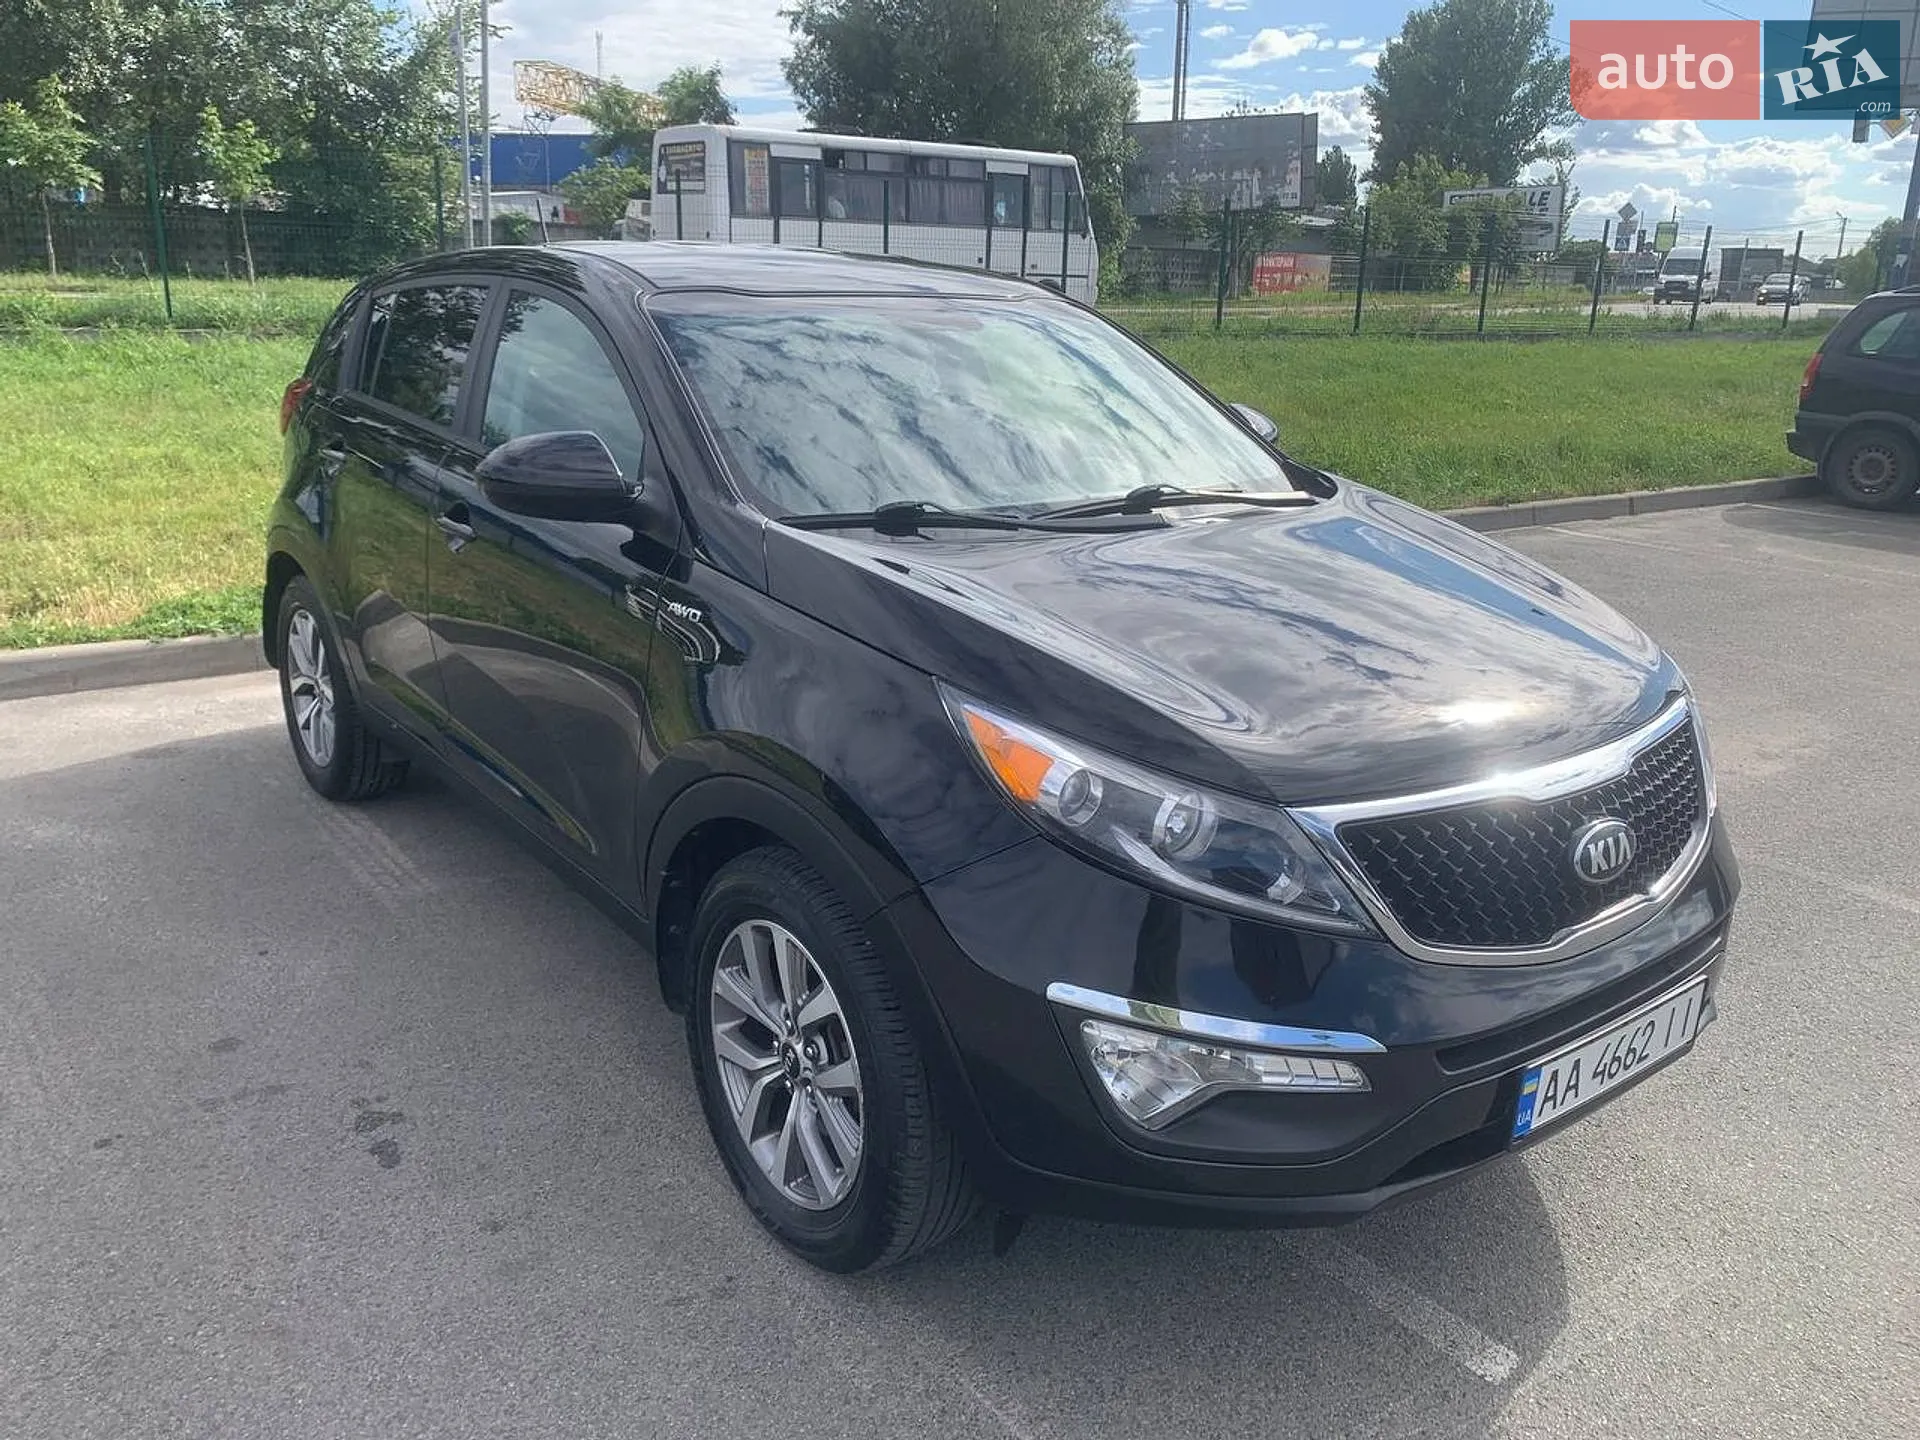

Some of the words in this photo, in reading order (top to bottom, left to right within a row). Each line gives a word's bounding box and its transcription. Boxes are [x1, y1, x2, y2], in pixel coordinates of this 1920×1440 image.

[1586, 832, 1631, 874] KIA
[1538, 1058, 1581, 1117] AA
[1592, 1019, 1656, 1085] 4662
[1517, 1109, 1531, 1126] UA
